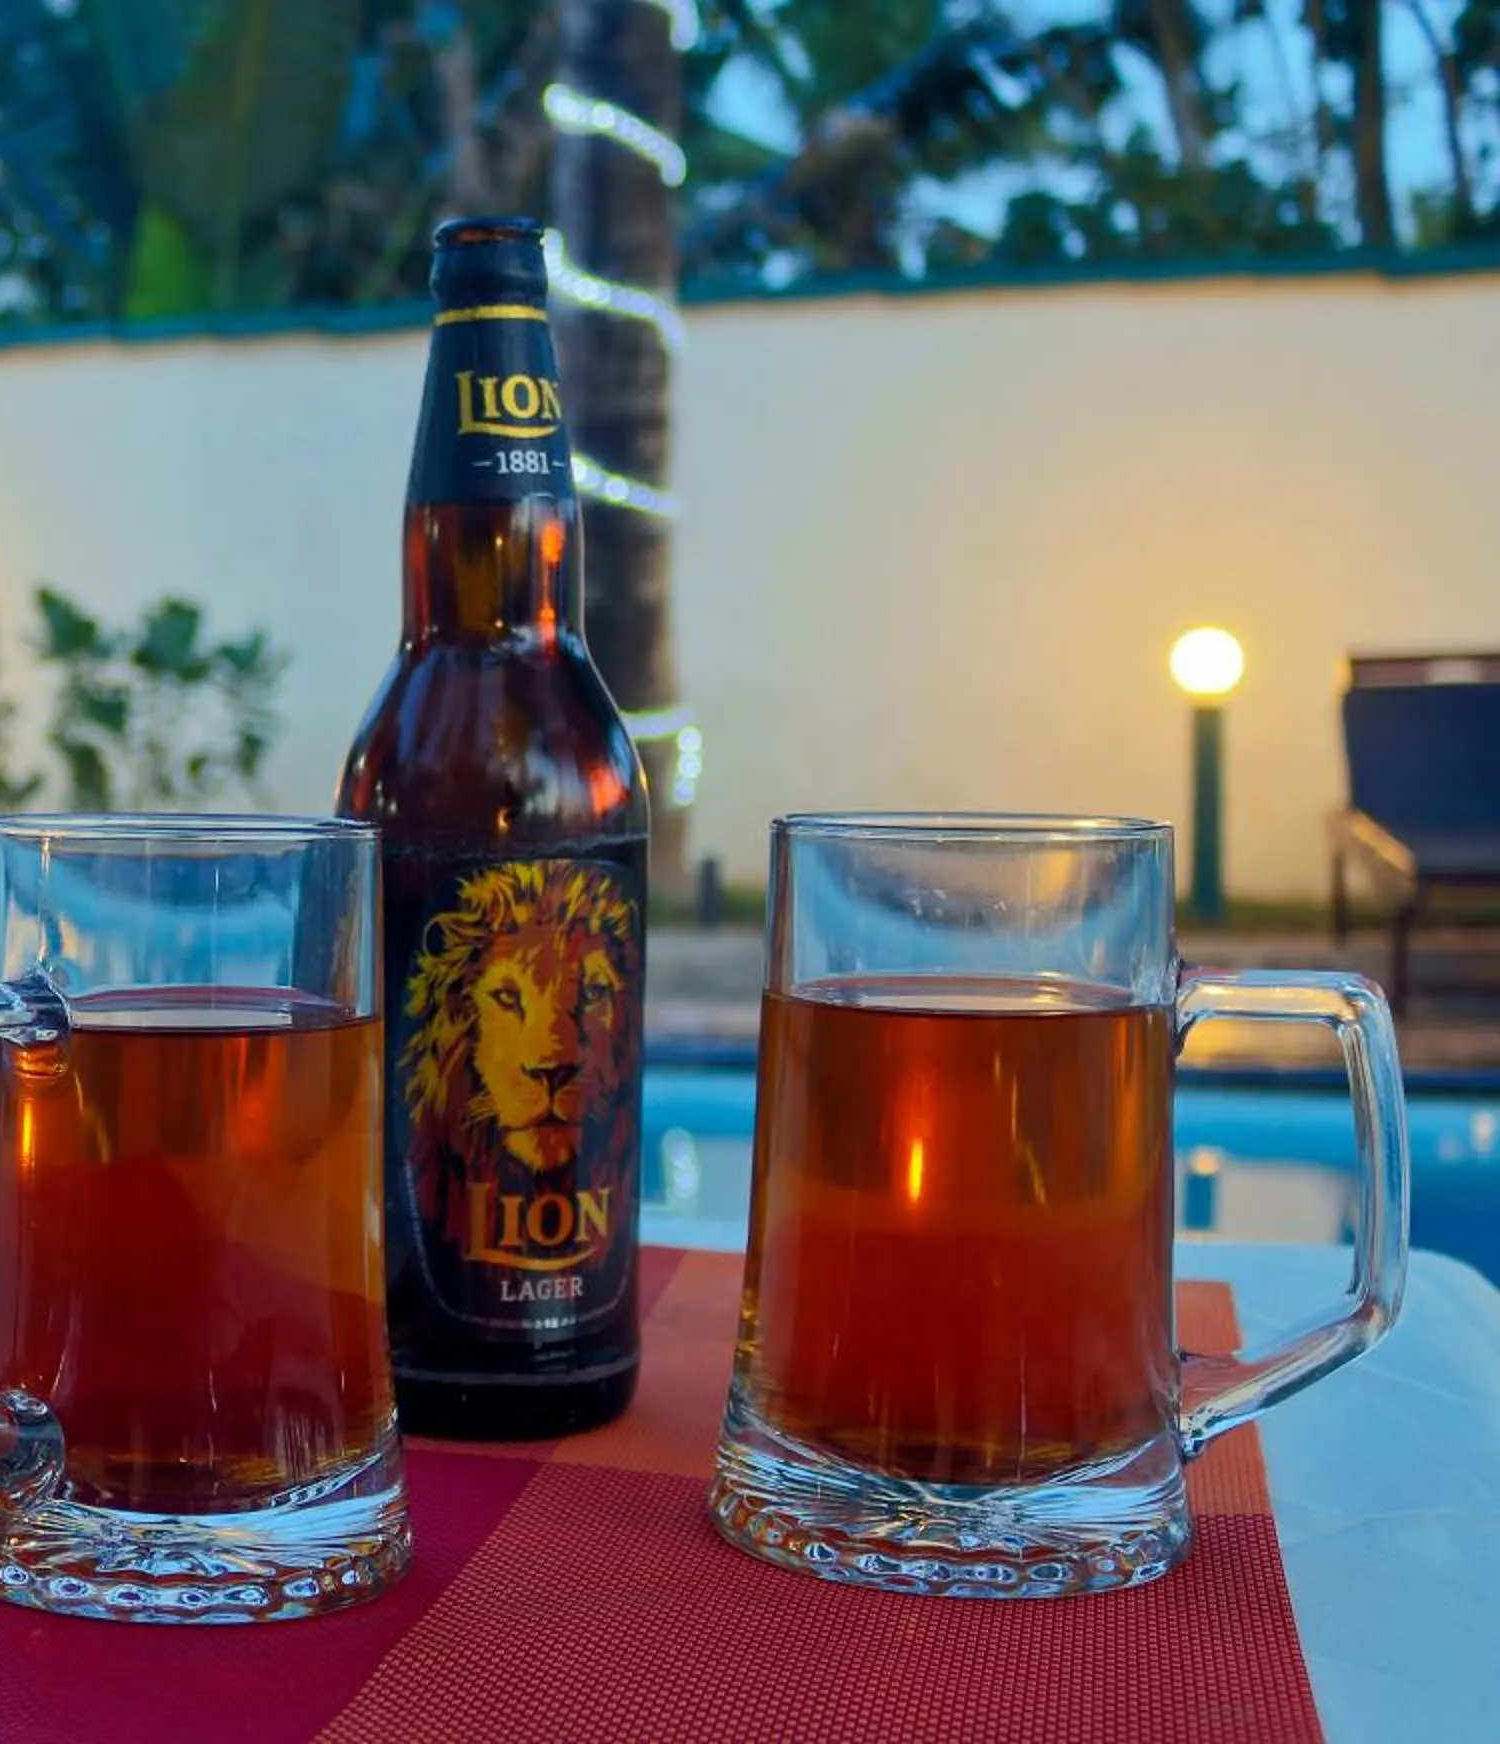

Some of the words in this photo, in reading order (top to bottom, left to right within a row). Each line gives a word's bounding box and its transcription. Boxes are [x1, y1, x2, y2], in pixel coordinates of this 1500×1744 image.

[455, 371, 562, 439] LION
[465, 1182, 612, 1271] LION
[500, 1276, 584, 1302] LAGER
